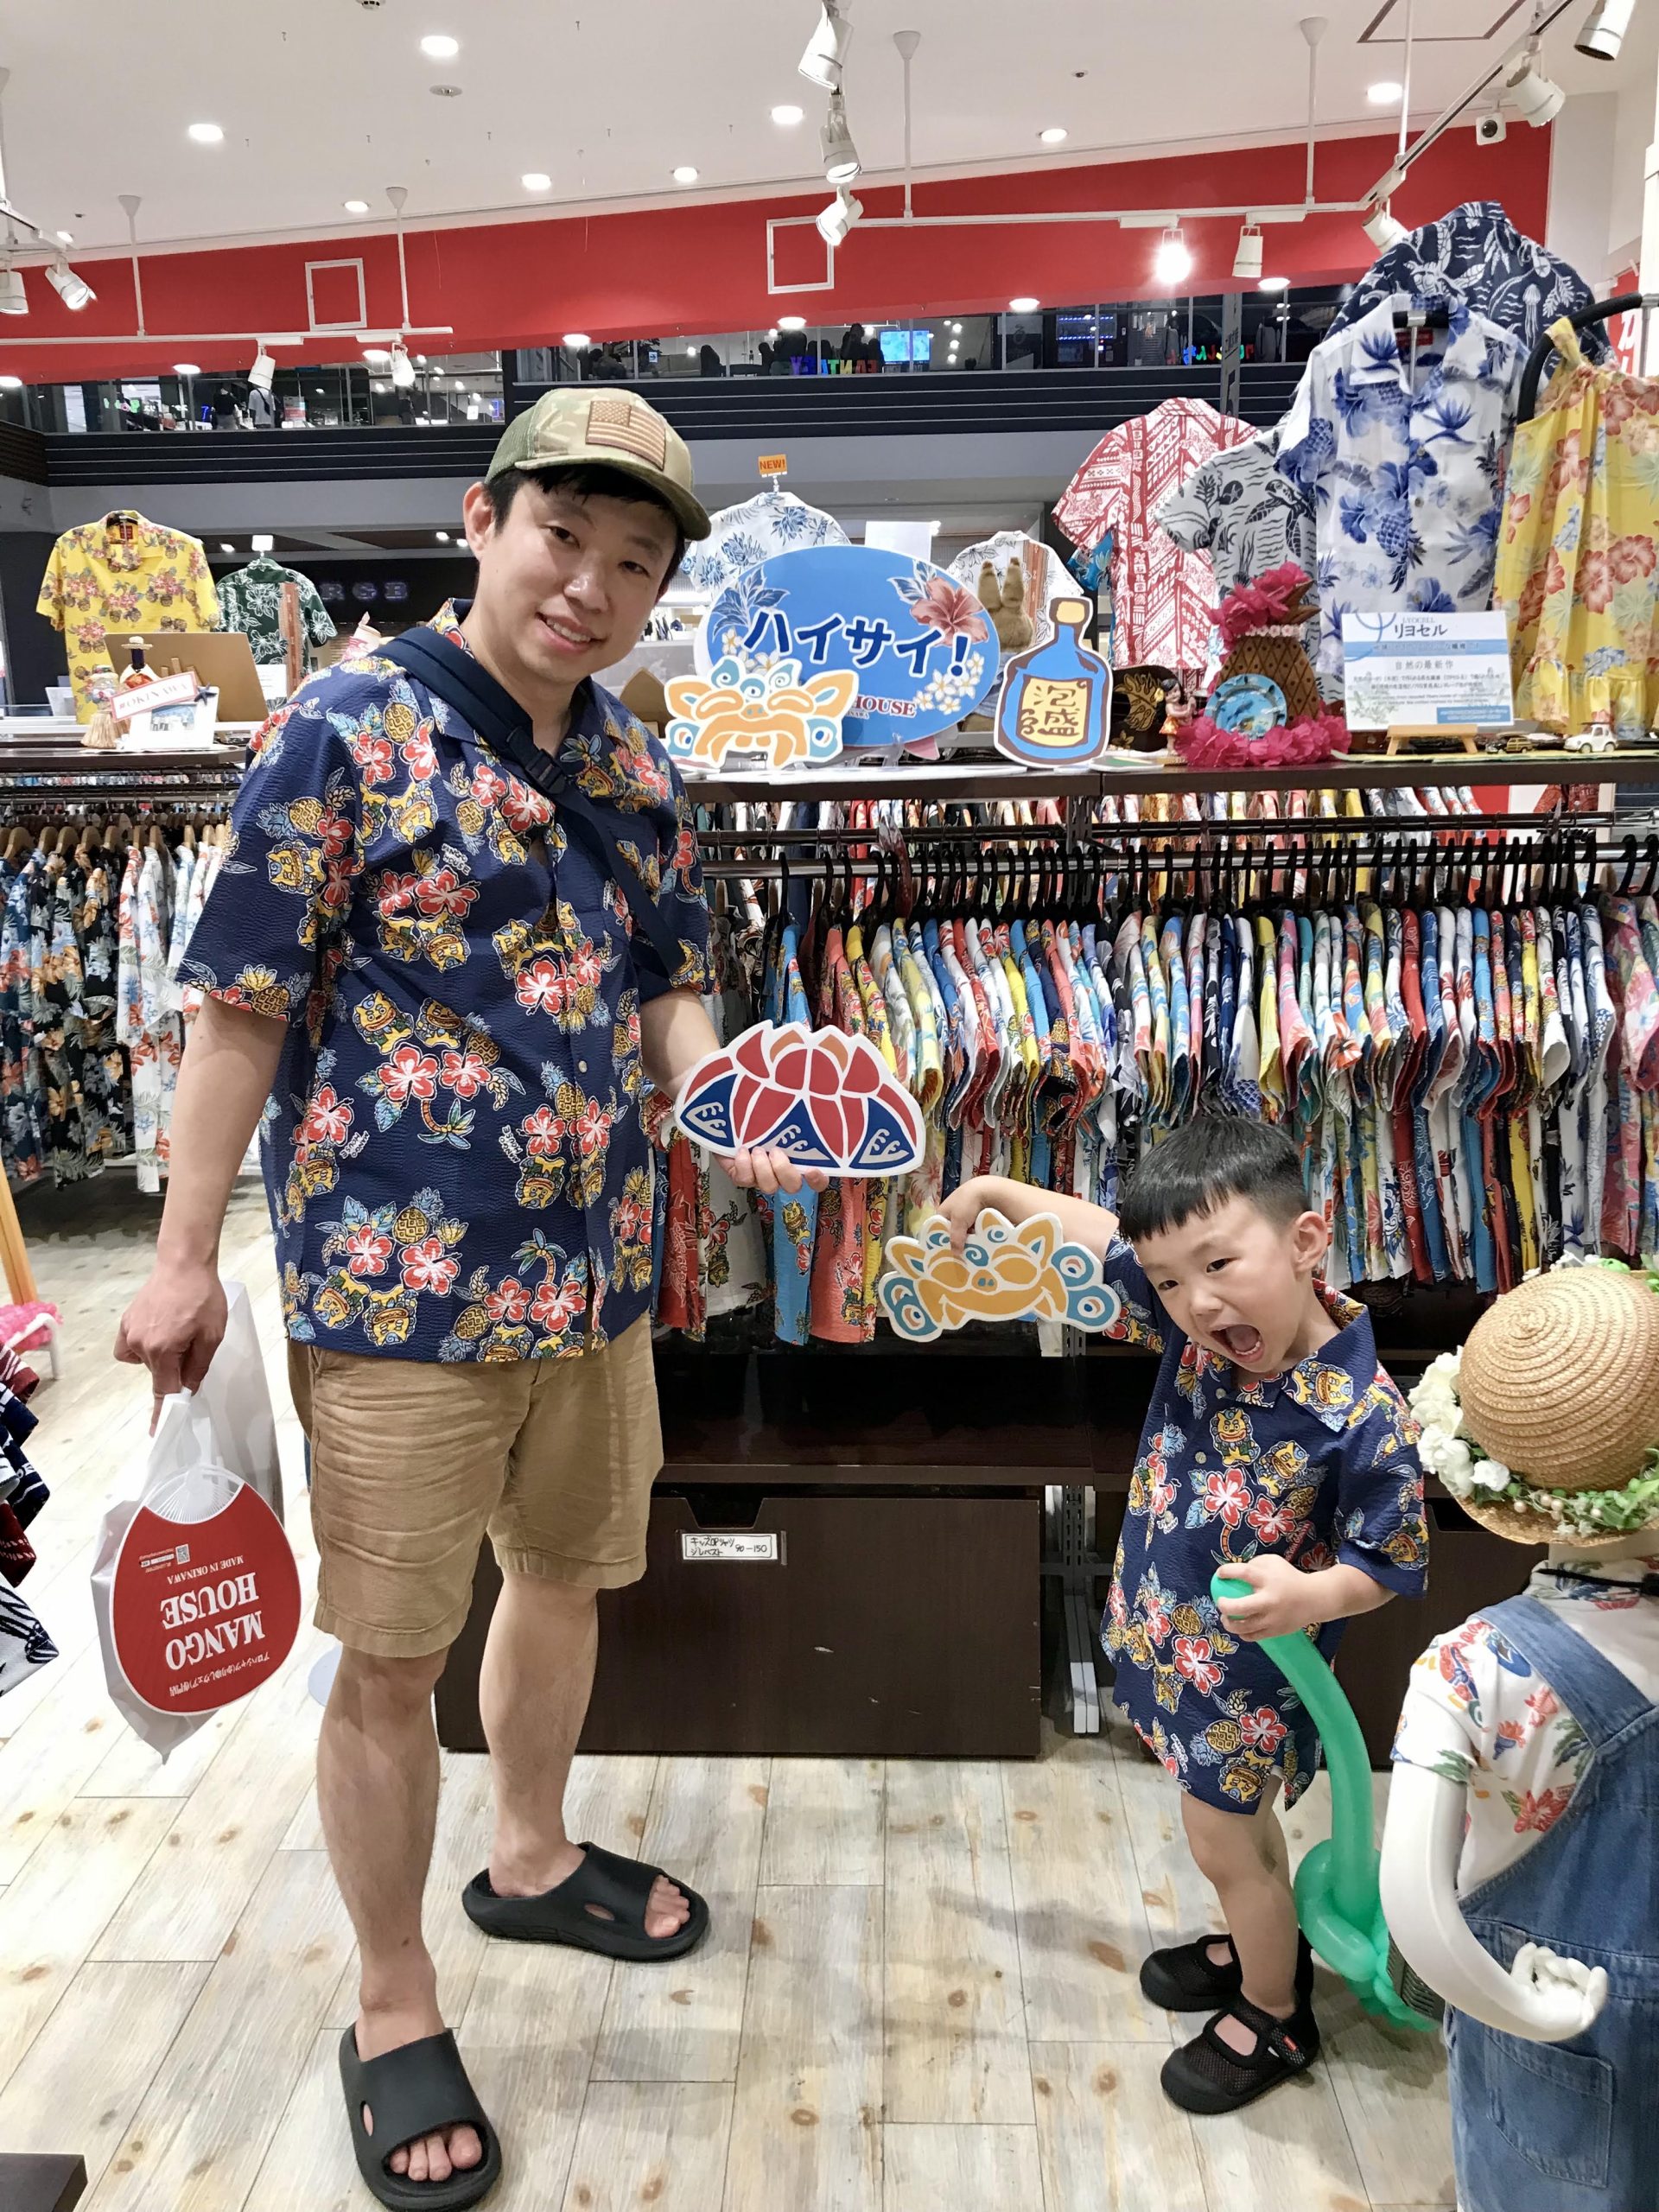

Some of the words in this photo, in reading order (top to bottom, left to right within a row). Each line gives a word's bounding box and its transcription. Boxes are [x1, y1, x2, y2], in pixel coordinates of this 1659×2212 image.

[760, 459, 785, 470] NEW!
[743, 610, 969, 677] ハイサイ!
[1033, 685, 1081, 736] 泡盛
[340, 1132, 361, 1159] HOUSE
[351, 1130, 370, 1158] MANGO
[499, 1136, 520, 1163] MANGO
[502, 1125, 523, 1153] HOUSE
[167, 1565, 208, 1585] OKINAWA
[209, 1561, 219, 1573] IN
[219, 1555, 244, 1569] MADE
[160, 1572, 259, 1630] HOUSE
[165, 1611, 265, 1670] MANGO
